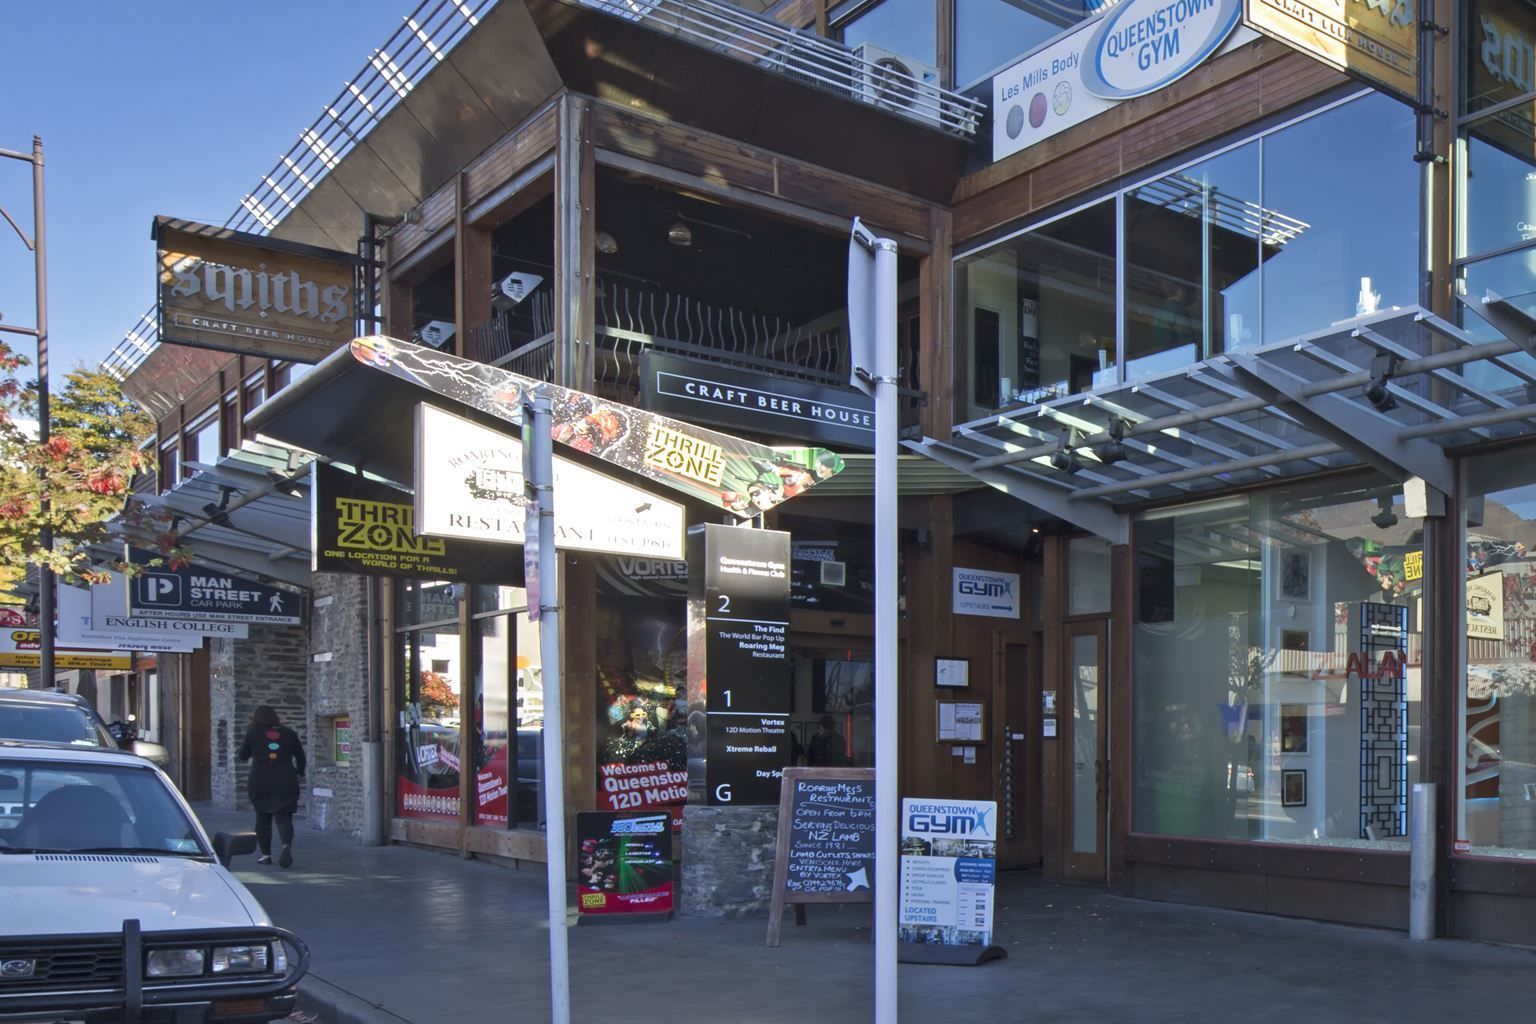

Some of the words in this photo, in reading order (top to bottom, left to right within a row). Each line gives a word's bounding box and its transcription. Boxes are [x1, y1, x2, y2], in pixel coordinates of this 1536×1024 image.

[1138, 28, 1180, 71] GYM
[1358, 38, 1400, 66] HOUSE
[1001, 82, 1020, 102] Les
[1022, 67, 1048, 91] Mills
[1052, 52, 1080, 76] Body
[192, 318, 237, 332] CRAFT
[246, 326, 279, 338] BEER
[685, 382, 748, 404] CRAFT
[758, 396, 802, 414] BEER
[811, 405, 871, 426] HOUSE
[653, 428, 722, 465] THRILL
[646, 444, 720, 482] ZONE
[324, 550, 345, 558] ONE
[348, 552, 397, 561] LOCATION
[400, 555, 421, 563] FOR
[362, 559, 397, 569] WORLD
[400, 562, 413, 570] OF
[417, 565, 458, 575] THRILLS!
[770, 570, 785, 578] Club
[190, 575, 233, 589] MAN
[958, 573, 1005, 583] QUEENSTOWN
[190, 588, 262, 602] STREET
[958, 581, 1005, 597] GYM
[190, 599, 213, 608] CAR
[216, 600, 244, 609] PARK
[718, 595, 730, 613] 2
[106, 617, 168, 630] ENGLISH
[172, 621, 236, 633] COLLEGE
[754, 625, 768, 633] The
[732, 632, 751, 640] World
[739, 641, 767, 651] Roaring
[768, 643, 784, 651] Meg
[752, 651, 784, 659] Restaurant
[723, 689, 731, 707] 1
[726, 745, 753, 753] Xtreme
[754, 745, 777, 753] Reball
[602, 762, 655, 776] Welcome
[656, 761, 667, 771] to
[756, 770, 770, 778] Day
[609, 791, 642, 810] 12D
[645, 785, 688, 805] Motio
[716, 783, 731, 801] G
[809, 793, 873, 803] RESTAURANT
[796, 808, 821, 817] OPEN
[909, 804, 976, 814] QUEENSTOWN
[909, 814, 975, 834] GYM
[904, 906, 937, 914] LOCATED
[904, 914, 938, 923] UPSTAIRS
